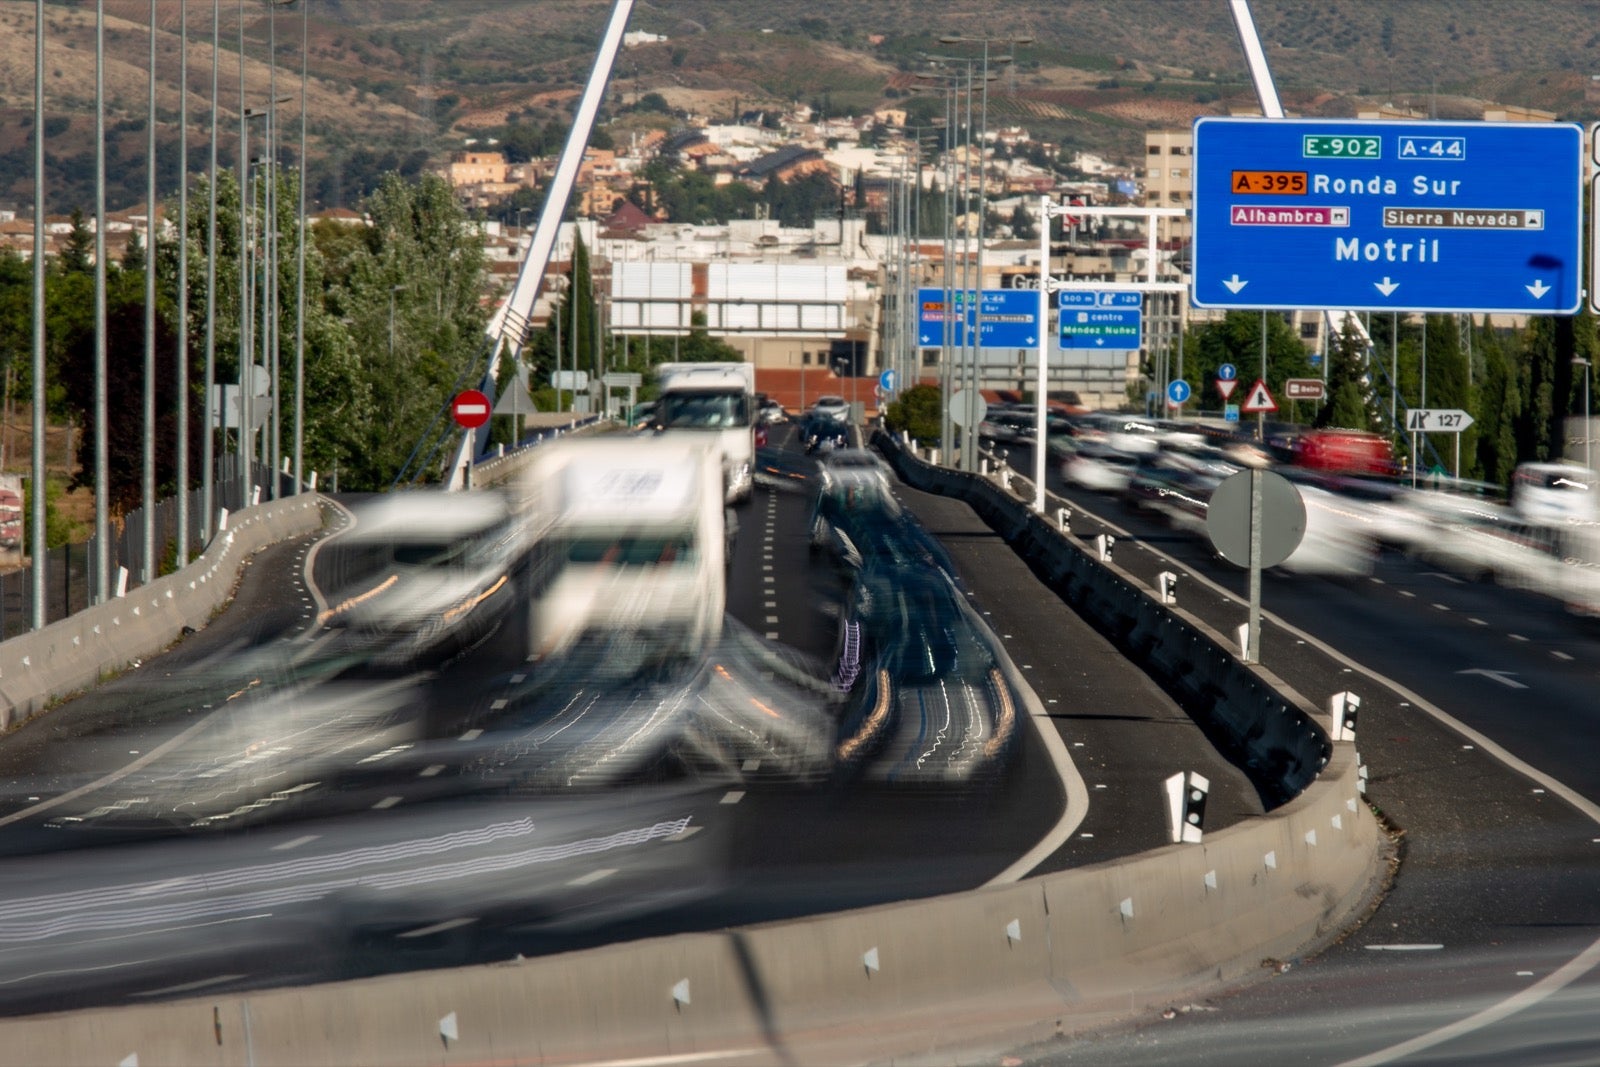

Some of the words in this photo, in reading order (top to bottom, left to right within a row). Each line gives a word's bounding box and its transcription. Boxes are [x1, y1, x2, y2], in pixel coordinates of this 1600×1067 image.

[1306, 138, 1378, 156] E-902
[1402, 140, 1462, 156] A-44
[1236, 175, 1305, 191] A-395
[1314, 174, 1397, 194] Ronda
[1413, 176, 1461, 196] Sur
[1235, 209, 1324, 224] Alhambra
[1388, 210, 1444, 225] Sierra
[1453, 211, 1518, 226] Nevada
[1335, 237, 1440, 263] Motril
[1012, 274, 1043, 290] Gra
[1091, 313, 1123, 321] centro
[1437, 415, 1462, 426] 127
